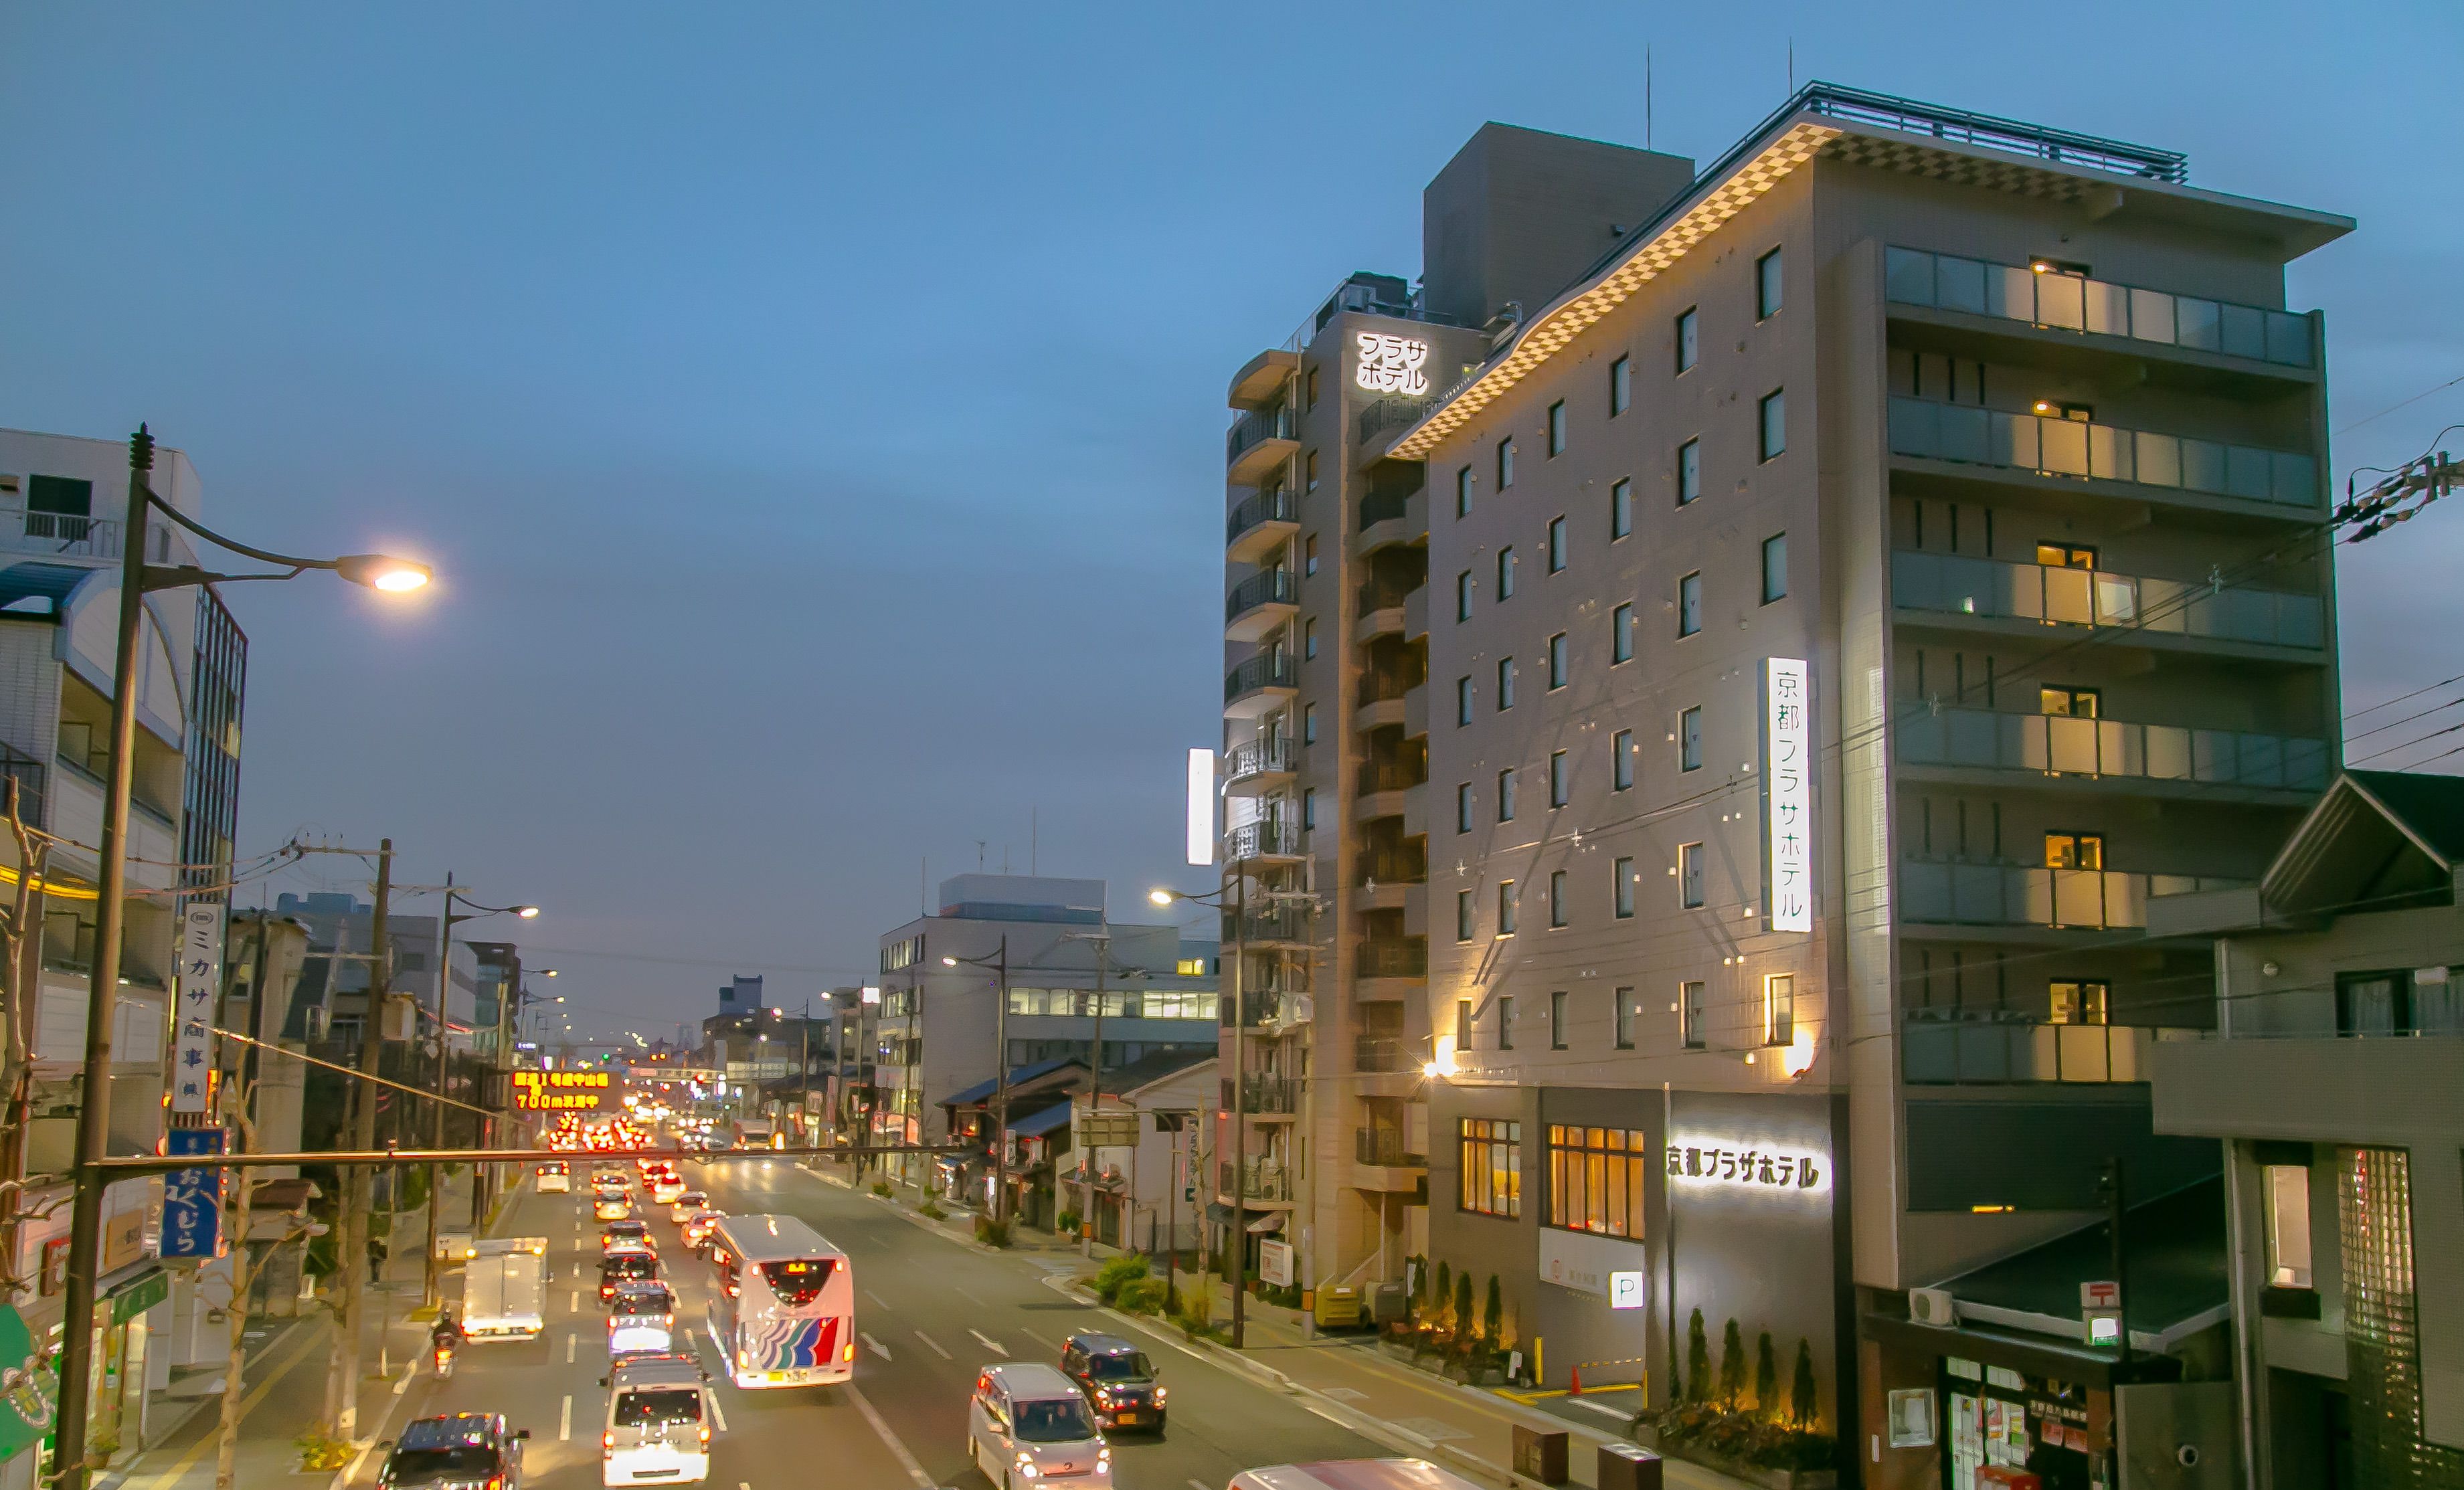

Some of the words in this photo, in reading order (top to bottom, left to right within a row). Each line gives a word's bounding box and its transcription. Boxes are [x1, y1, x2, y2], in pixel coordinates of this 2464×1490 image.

[1363, 363, 1426, 389] ホテル
[1620, 1279, 1635, 1301] P
